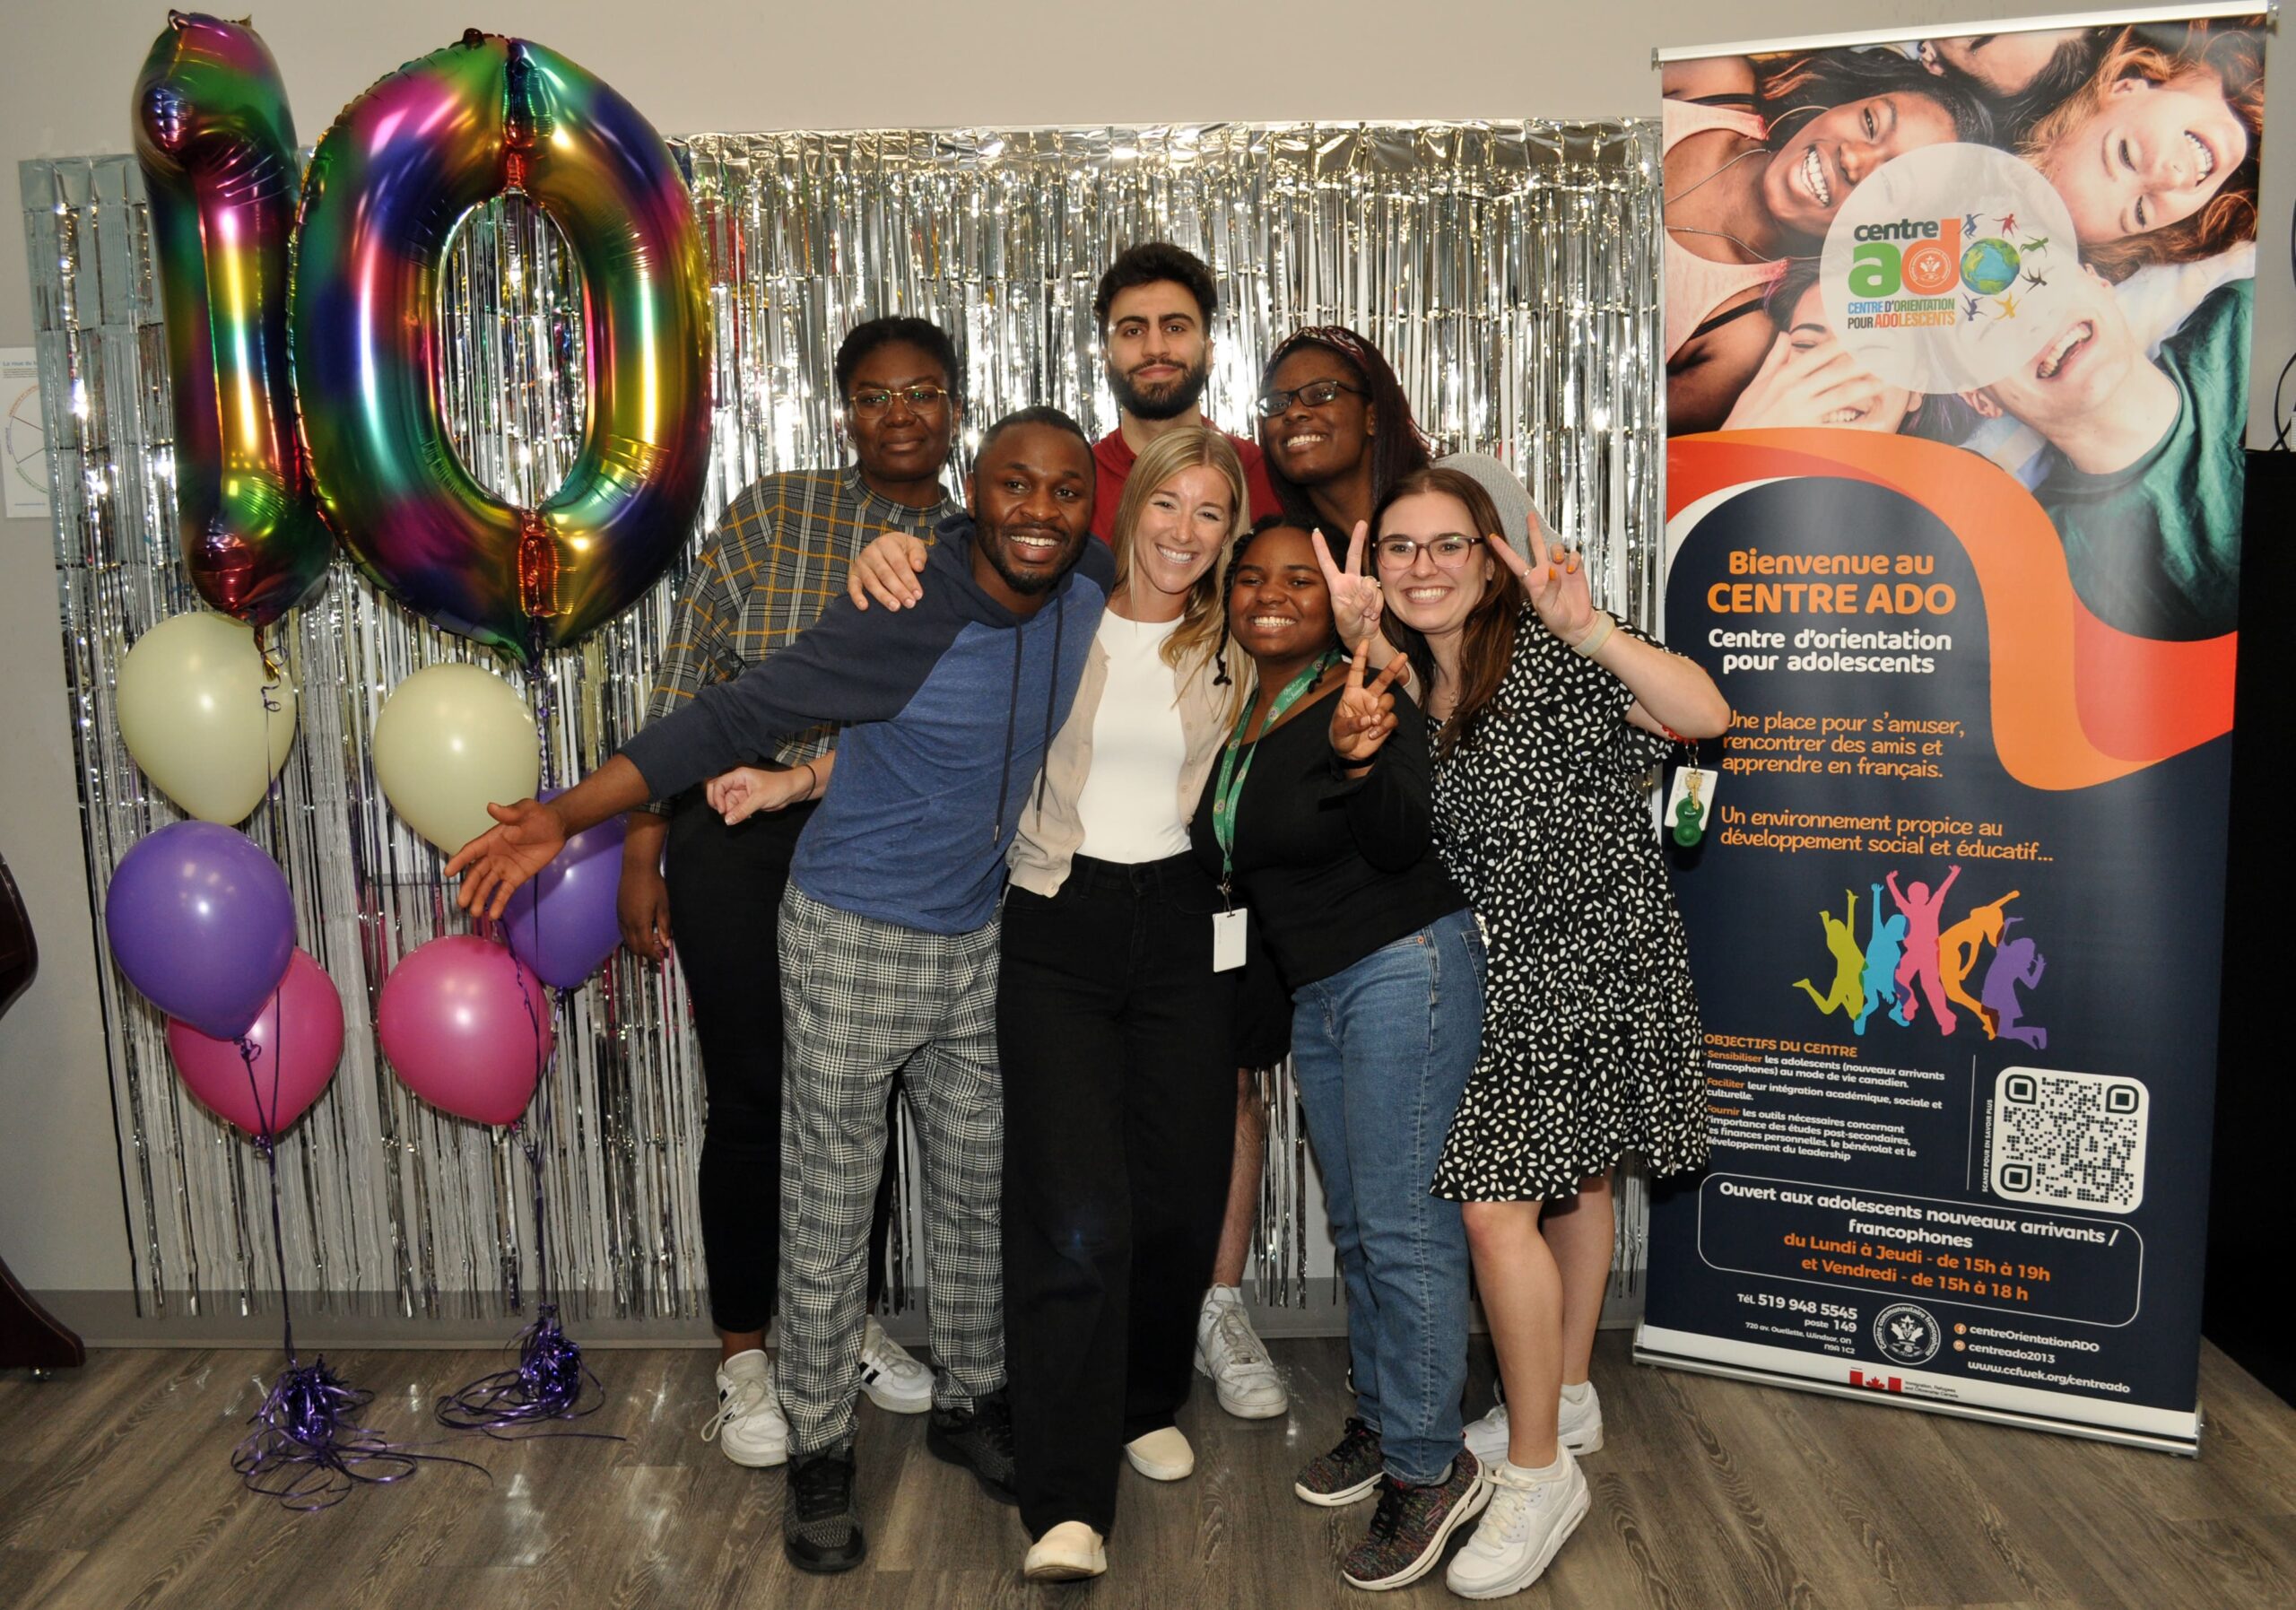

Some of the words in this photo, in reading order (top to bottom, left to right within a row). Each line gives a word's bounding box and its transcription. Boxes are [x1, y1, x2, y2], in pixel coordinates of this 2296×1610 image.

[1854, 218, 1938, 242] centre
[1848, 301, 1883, 314] CENTRE
[1884, 298, 1955, 312] D'ORIENTATION
[1848, 316, 1874, 329] POUR
[1874, 311, 1955, 328] ADOLESCENTS
[1728, 548, 1890, 575] Bienvenue
[1894, 554, 1934, 575] au
[1708, 582, 1858, 614] CENTRE
[1865, 582, 1956, 615] ADO
[1708, 628, 1786, 648] Centre
[1794, 627, 1952, 651] d'orientation
[1723, 654, 1779, 674] pour
[1787, 651, 1935, 674] adolescents
[1764, 711, 1816, 735] place
[1822, 716, 1867, 735] pour
[1872, 710, 1965, 739] s'amuser,
[1722, 734, 1824, 753] rencontrer
[1831, 736, 1866, 754] des
[1871, 738, 1917, 756] amis
[1922, 740, 1944, 757] et
[1721, 754, 1822, 776] apprendre
[1827, 760, 1852, 775] en
[1857, 757, 1944, 781] français.
[1720, 805, 1746, 825] Un
[1751, 808, 1892, 831] environnement
[1897, 815, 1973, 839] propice
[1979, 822, 2004, 838] au
[1720, 828, 1863, 853] développement
[1868, 835, 1924, 856] social
[1930, 840, 1951, 857] et
[1956, 840, 2054, 862] éducatif...
[1704, 1033, 1777, 1050] OBJECTIFS
[1779, 1040, 1801, 1052] DU
[1804, 1042, 1858, 1058] CENTRE
[1707, 1049, 1763, 1063] Sensibiliser
[1764, 1055, 1779, 1065] les
[1780, 1056, 1841, 1070] adolescents
[1843, 1062, 1896, 1075] (nouveaux
[1898, 1068, 1945, 1081] arrivants
[1707, 1059, 1779, 1075] francophones)
[1779, 1068, 1794, 1076] au
[1796, 1069, 1825, 1079] mode
[1826, 1071, 1839, 1082] de
[1841, 1073, 1857, 1083] vie
[1858, 1075, 1909, 1088] canadien.
[1707, 1077, 1745, 1089] Faciliter
[1747, 1081, 1768, 1091] leur
[1769, 1083, 1823, 1096] intégration
[1825, 1090, 1892, 1104] académique,
[1893, 1096, 1930, 1108] sociale
[1931, 1101, 1943, 1110] et
[1707, 1088, 1754, 1101] culturelle.
[1743, 1108, 1757, 1118] les
[1758, 1111, 1786, 1121] outils
[1787, 1113, 1845, 1127] nécessaires
[1847, 1120, 1905, 1134] concernant
[1768, 1122, 1787, 1131] des
[1787, 1124, 1822, 1136] études
[1823, 1128, 1910, 1146] post-secondaires,
[1720, 1127, 1762, 1139] finances
[1763, 1133, 1829, 1147] personnelles,
[1831, 1139, 1840, 1148] le
[1842, 1140, 1892, 1154] bénévolat
[1894, 1147, 1905, 1156] et
[1907, 1148, 1917, 1157] le
[1782, 1144, 1796, 1154] du
[1797, 1146, 1851, 1162] leadership
[1984, 1140, 1991, 1149] EN
[1718, 1182, 1777, 1202] Ouvert
[1780, 1190, 1813, 1205] aux
[1817, 1193, 1923, 1221] adolescents
[1926, 1207, 2017, 1231] nouveaux
[2020, 1221, 2106, 1245] arrivants
[1848, 1218, 1974, 1249] francophones
[1783, 1232, 1806, 1248] du
[1810, 1235, 1857, 1255] Lundi
[1861, 1241, 1873, 1257] à
[1874, 1244, 1923, 1264] Jeudi
[1937, 1253, 1960, 1269] de
[1964, 1256, 1996, 1274] 15h
[2000, 1259, 2013, 1277] à
[2017, 1262, 2051, 1282] 19h
[1801, 1257, 1818, 1272] et
[1822, 1258, 1898, 1283] Vendredi
[1911, 1270, 1934, 1287] de
[1938, 1274, 1970, 1292] 15h
[1973, 1277, 1987, 1294] à
[1990, 1281, 2013, 1298] 18
[2016, 1284, 2029, 1301] h
[1758, 1293, 1786, 1309] 519
[1788, 1299, 1817, 1314] 948
[1820, 1303, 1857, 1320] 5545
[1745, 1321, 1759, 1330] 720
[1804, 1319, 1830, 1328] poste
[1833, 1319, 1857, 1333] 149
[1970, 1326, 2100, 1353] centreOrientationADO
[1969, 1343, 2056, 1364] centreado2013
[1968, 1360, 2131, 1394] www.ccfwek.org/centreado
